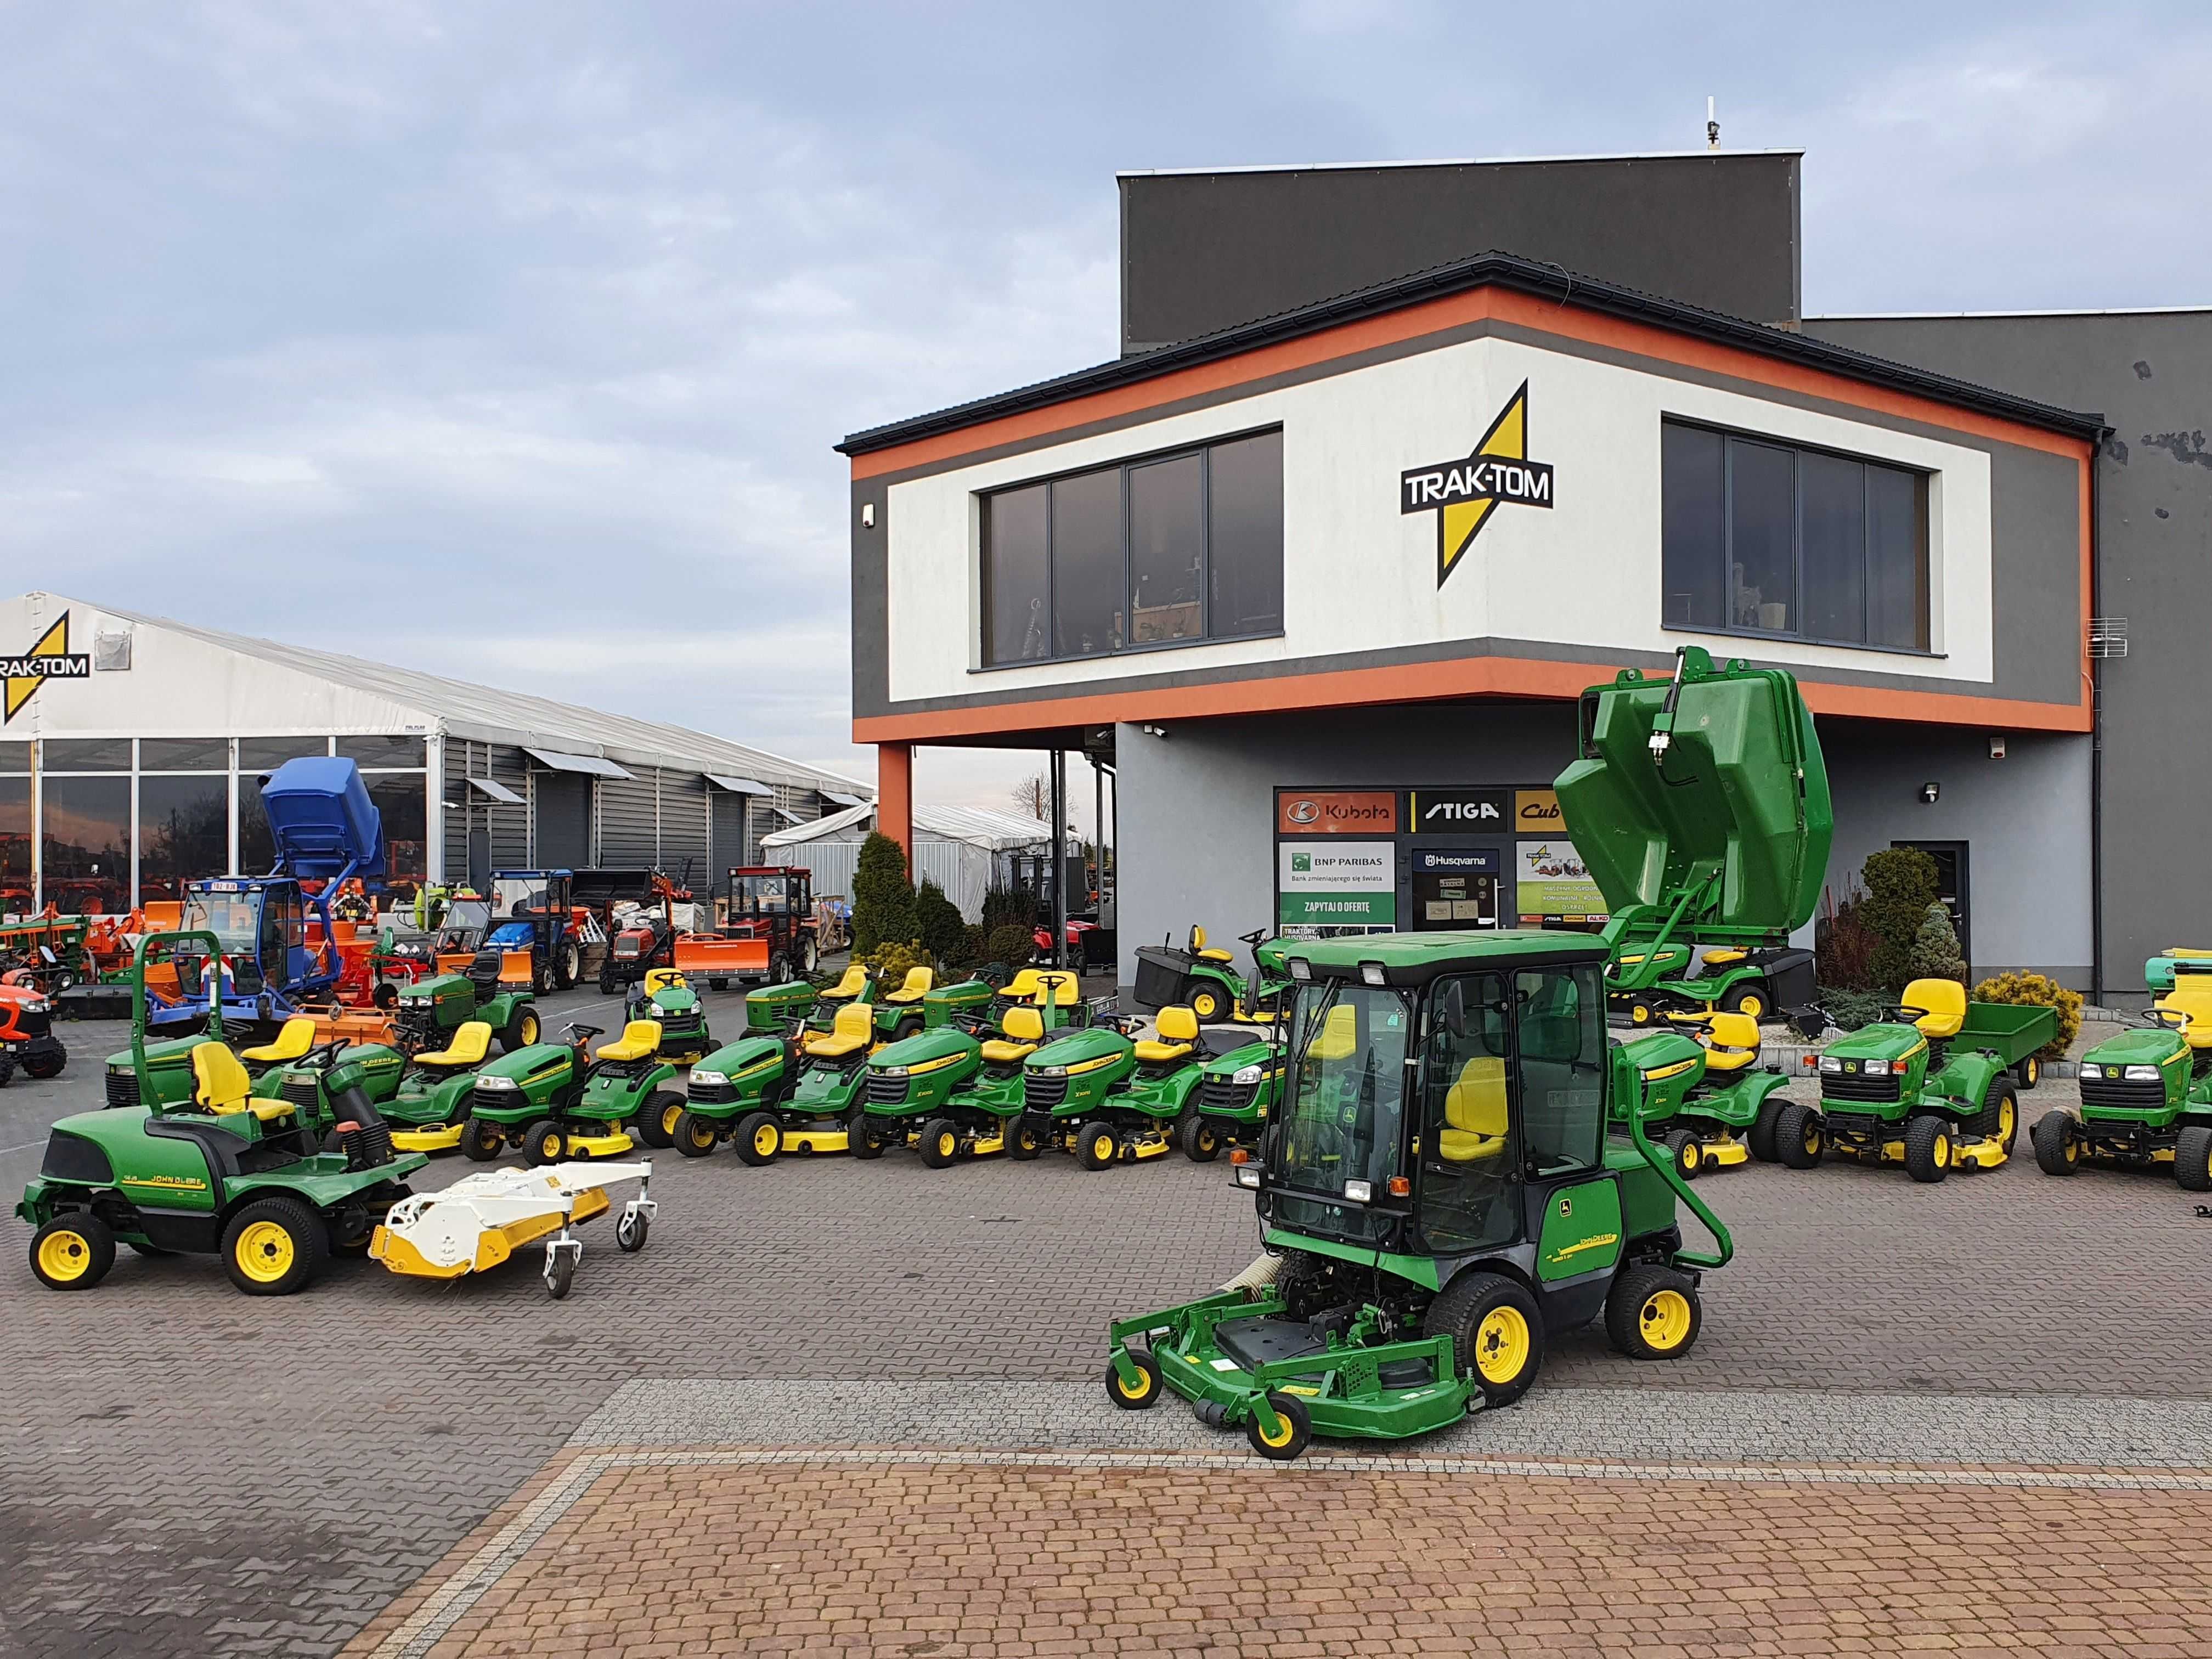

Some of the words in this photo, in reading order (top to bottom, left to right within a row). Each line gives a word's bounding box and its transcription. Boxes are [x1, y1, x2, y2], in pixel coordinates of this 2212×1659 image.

[1405, 462, 1549, 505] TRAK-TOM
[0, 658, 87, 676] RAK-TOM
[1325, 805, 1390, 819] Kubota
[1425, 803, 1499, 819] STIGA
[1520, 804, 1560, 819] Cub
[1436, 856, 1486, 866] Husqvarna
[1305, 902, 1336, 912] ZAPYTAJ
[1338, 902, 1342, 912] O
[1344, 902, 1370, 913] OFERTĘ
[174, 1177, 202, 1185] DEERE
